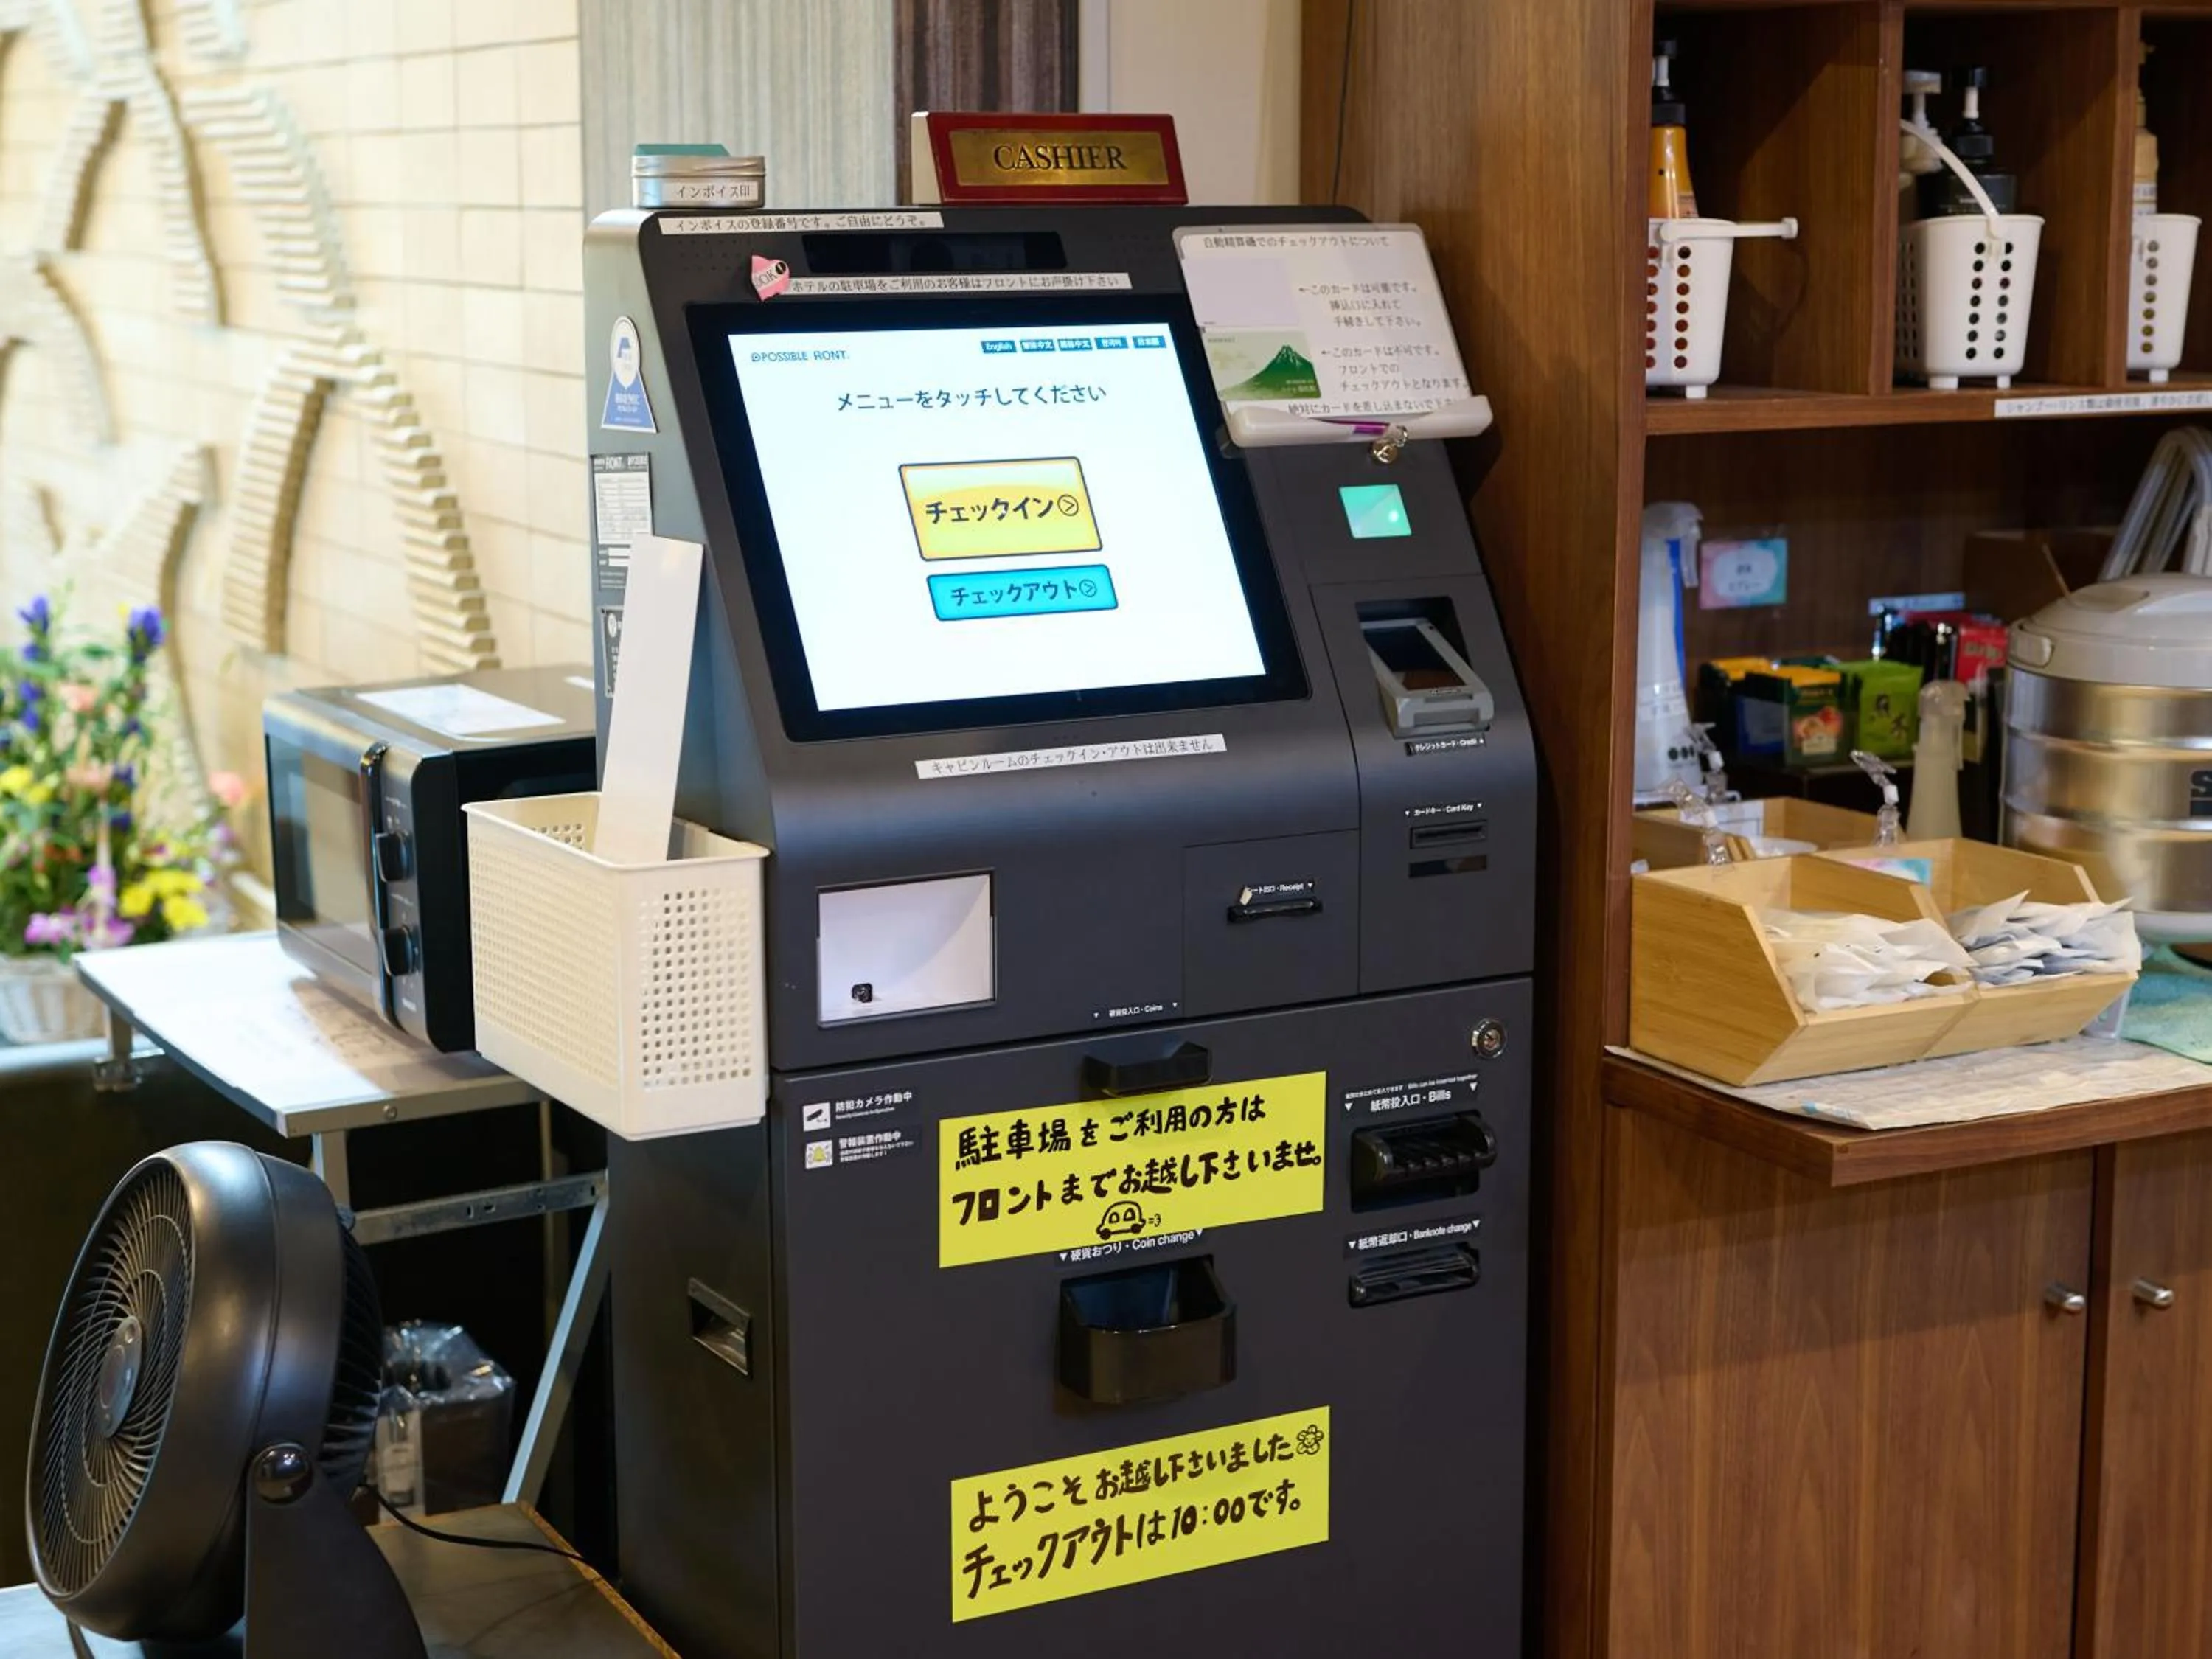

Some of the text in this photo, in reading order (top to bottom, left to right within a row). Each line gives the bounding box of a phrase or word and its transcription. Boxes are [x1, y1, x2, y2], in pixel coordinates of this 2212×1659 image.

[993, 145, 1127, 170] CASHIER
[677, 184, 751, 200] インボイス印
[838, 384, 1107, 411] メニューをタッチしてください
[925, 496, 1054, 524] チェックイン
[950, 579, 1078, 607] チェックアウト
[955, 1093, 1266, 1171] 駐車場をご利用の方は
[952, 1140, 1323, 1226] フロントまでお越し下さいませ。
[1157, 1231, 1194, 1244] change
